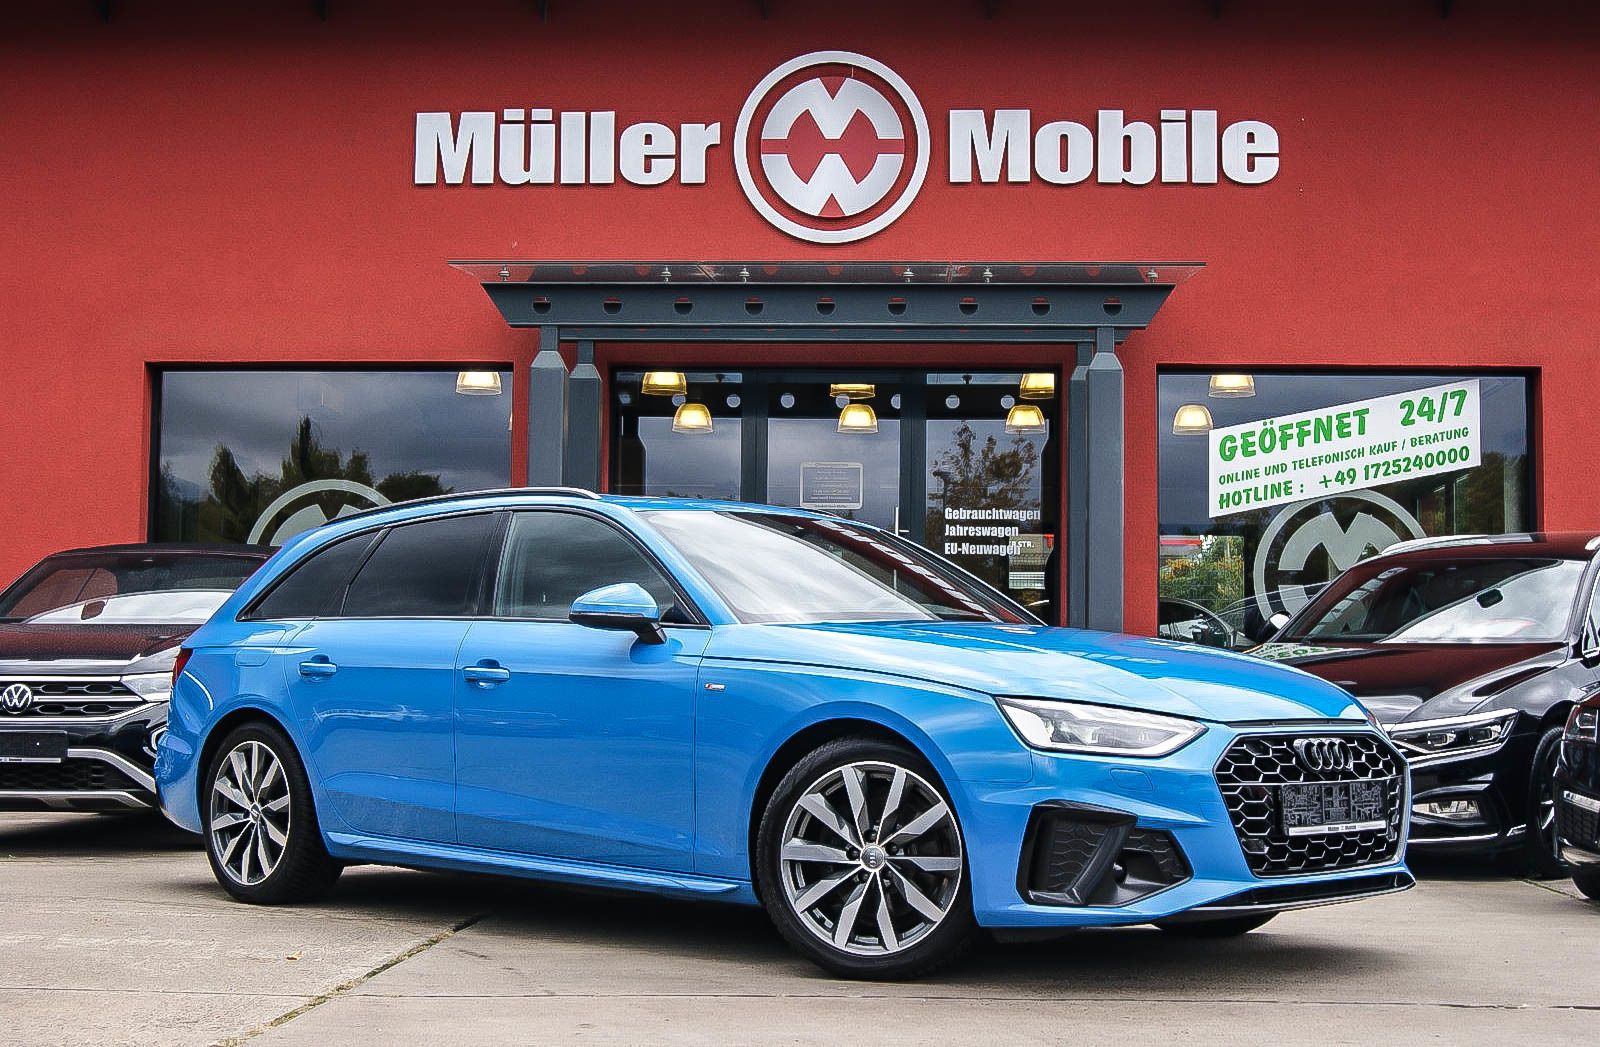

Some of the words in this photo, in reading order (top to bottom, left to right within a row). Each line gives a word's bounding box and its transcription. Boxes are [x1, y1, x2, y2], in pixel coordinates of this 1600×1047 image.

[414, 108, 721, 186] Müller
[949, 109, 1280, 185] Mobile
[1218, 408, 1370, 462] GEÖFFNET
[1399, 388, 1468, 427] 24/7
[1218, 467, 1261, 486] ONLINE
[1264, 462, 1288, 477] UND
[1291, 446, 1366, 470] TELEFONISCH
[1369, 440, 1399, 456] KAUF
[1410, 426, 1470, 448] BERATUNG
[1218, 479, 1294, 510] HOTLINE
[1318, 467, 1357, 489] +49
[1363, 445, 1471, 481] 1725240000
[944, 506, 1041, 521] Gebrauchtwagen
[944, 523, 1019, 538] Jahreswagen
[944, 541, 1021, 557] EU-Neuwagen
